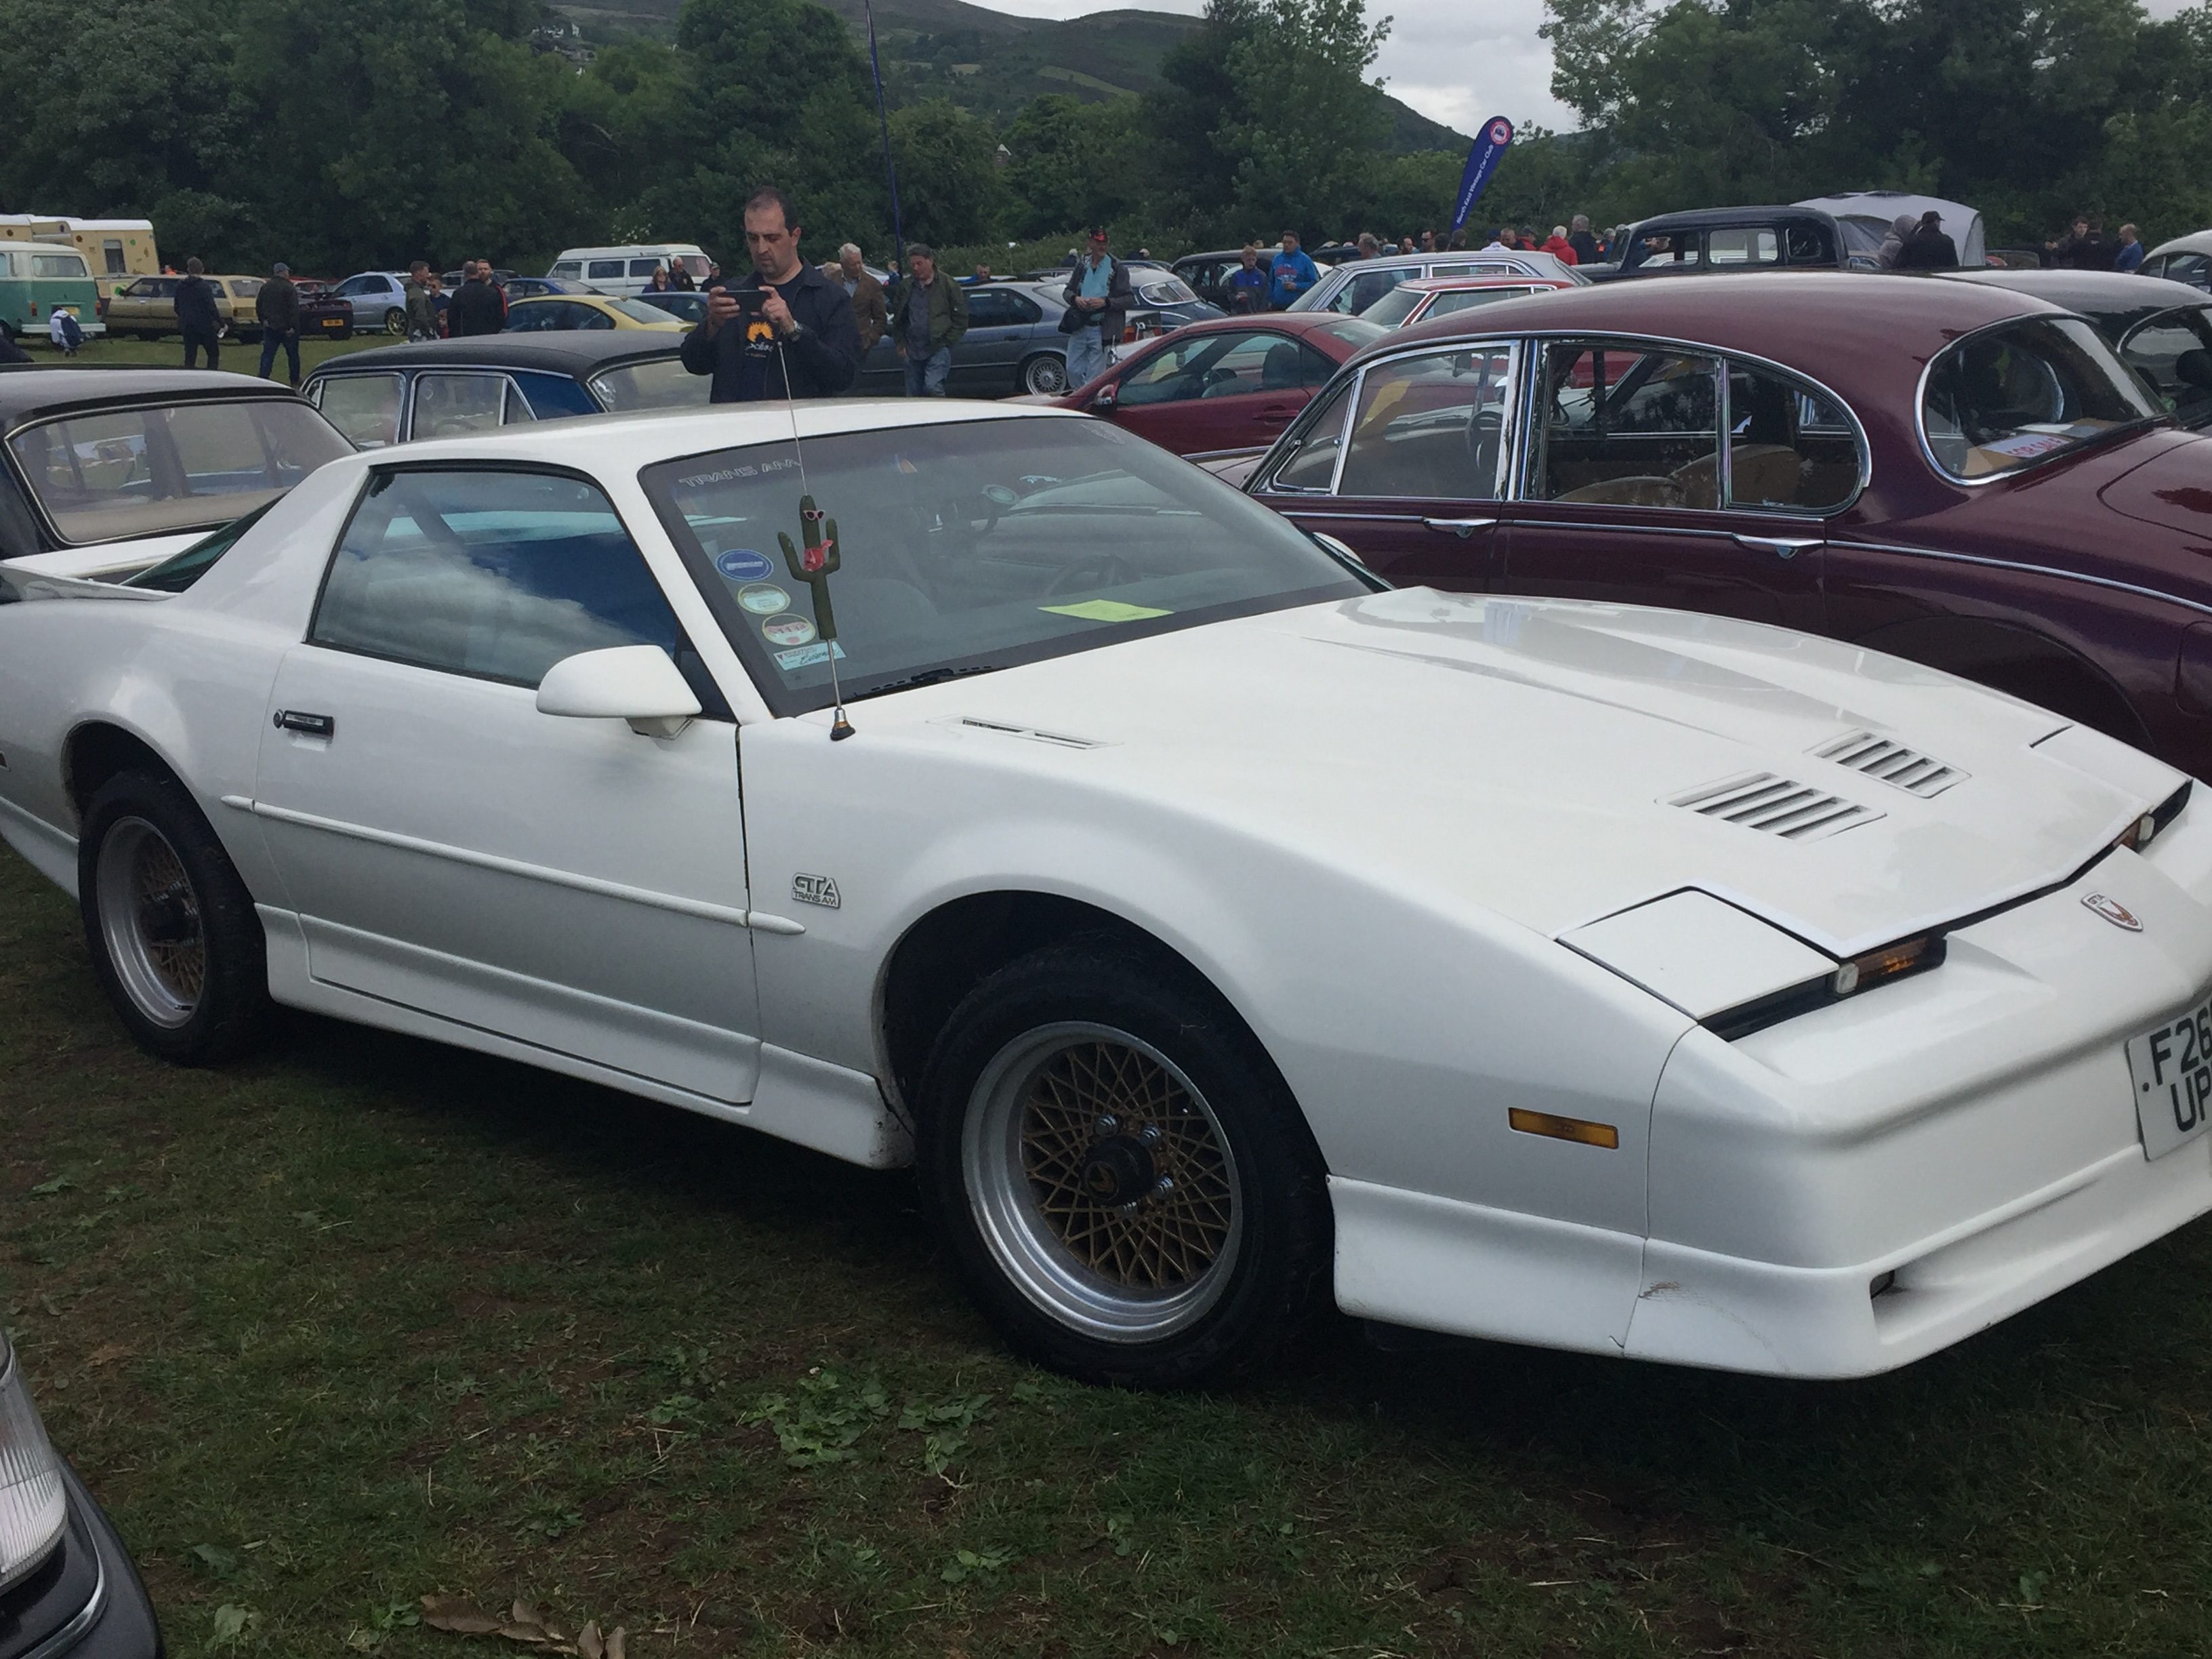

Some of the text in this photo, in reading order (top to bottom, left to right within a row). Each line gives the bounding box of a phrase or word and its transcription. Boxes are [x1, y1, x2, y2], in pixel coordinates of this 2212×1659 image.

[1456, 205, 1467, 224] North
[1464, 192, 1473, 206] East
[1469, 169, 1482, 192] Vintage
[1485, 144, 1494, 159] Club
[678, 466, 758, 487] TRANS
[793, 873, 838, 896] GTA
[794, 890, 837, 906] TRANS AM
[2150, 999, 2212, 1086] F26
[2171, 1065, 2212, 1132] UP
